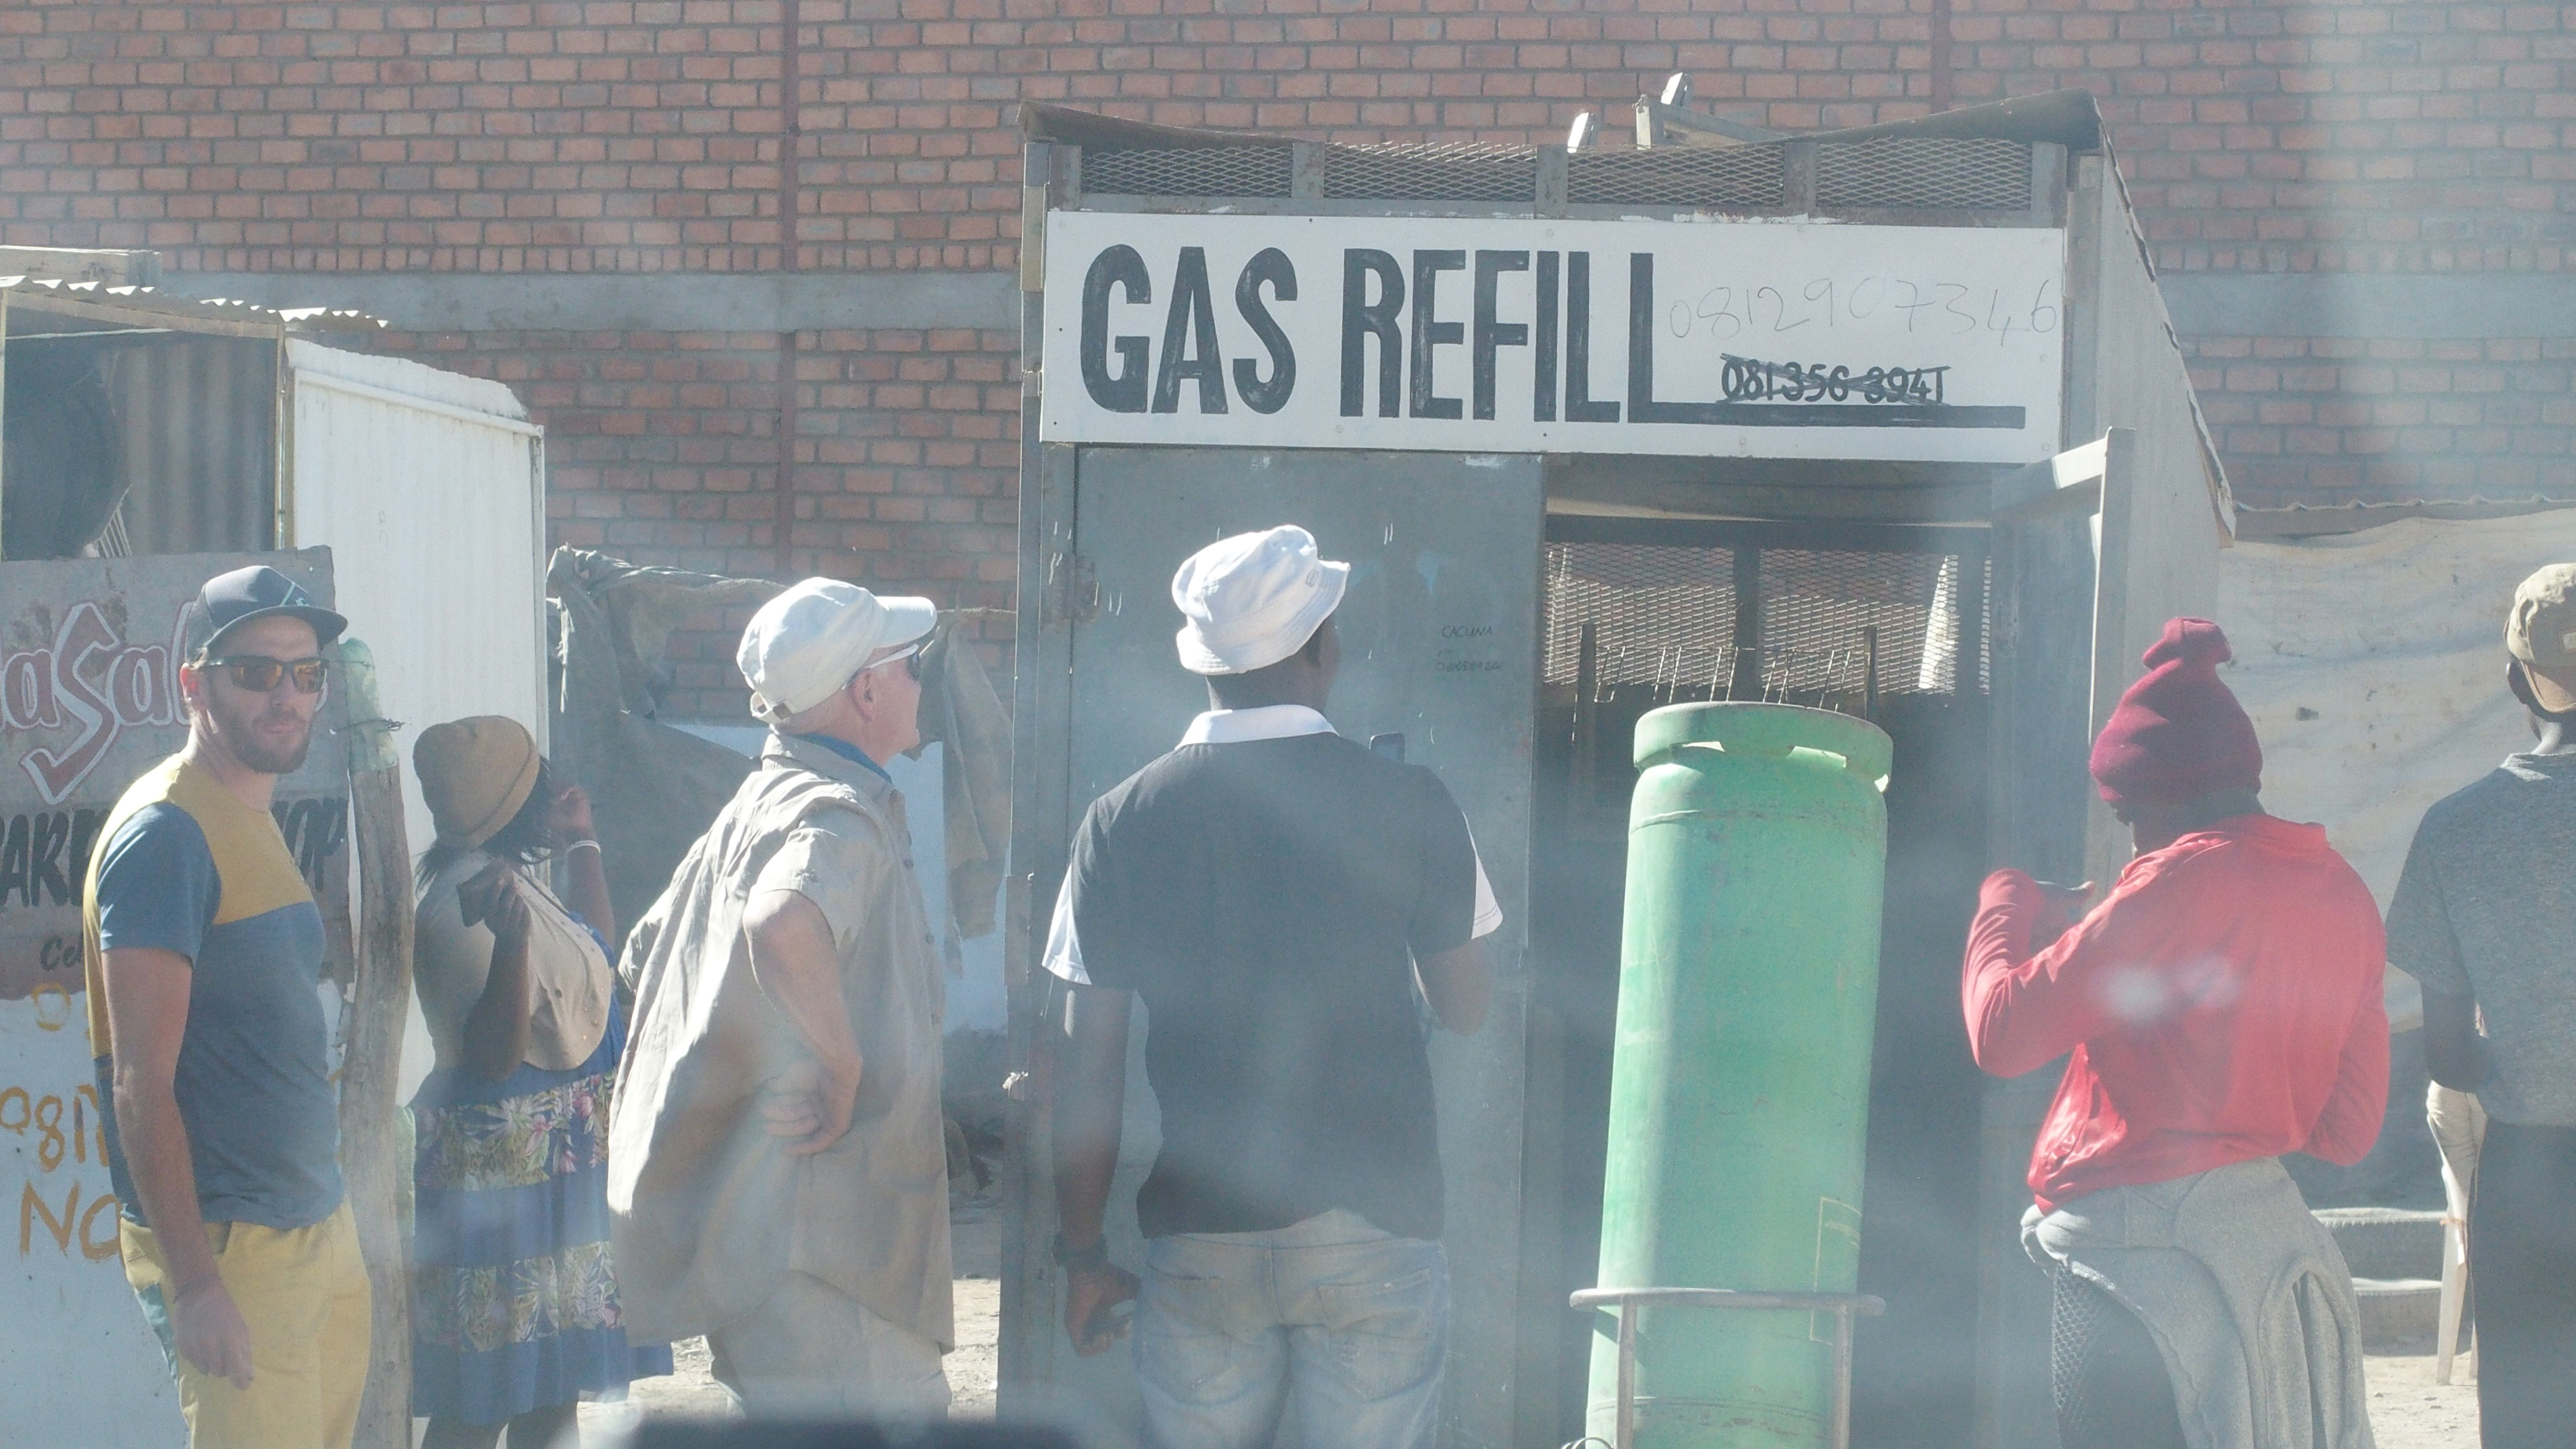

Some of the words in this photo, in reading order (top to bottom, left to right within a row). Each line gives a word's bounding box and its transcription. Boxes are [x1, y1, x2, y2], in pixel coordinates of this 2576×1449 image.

[1080, 243, 1298, 415] GAS
[1340, 248, 1687, 425] REFILL
[1670, 277, 2057, 347] 0812907346
[271, 797, 349, 892] OP
